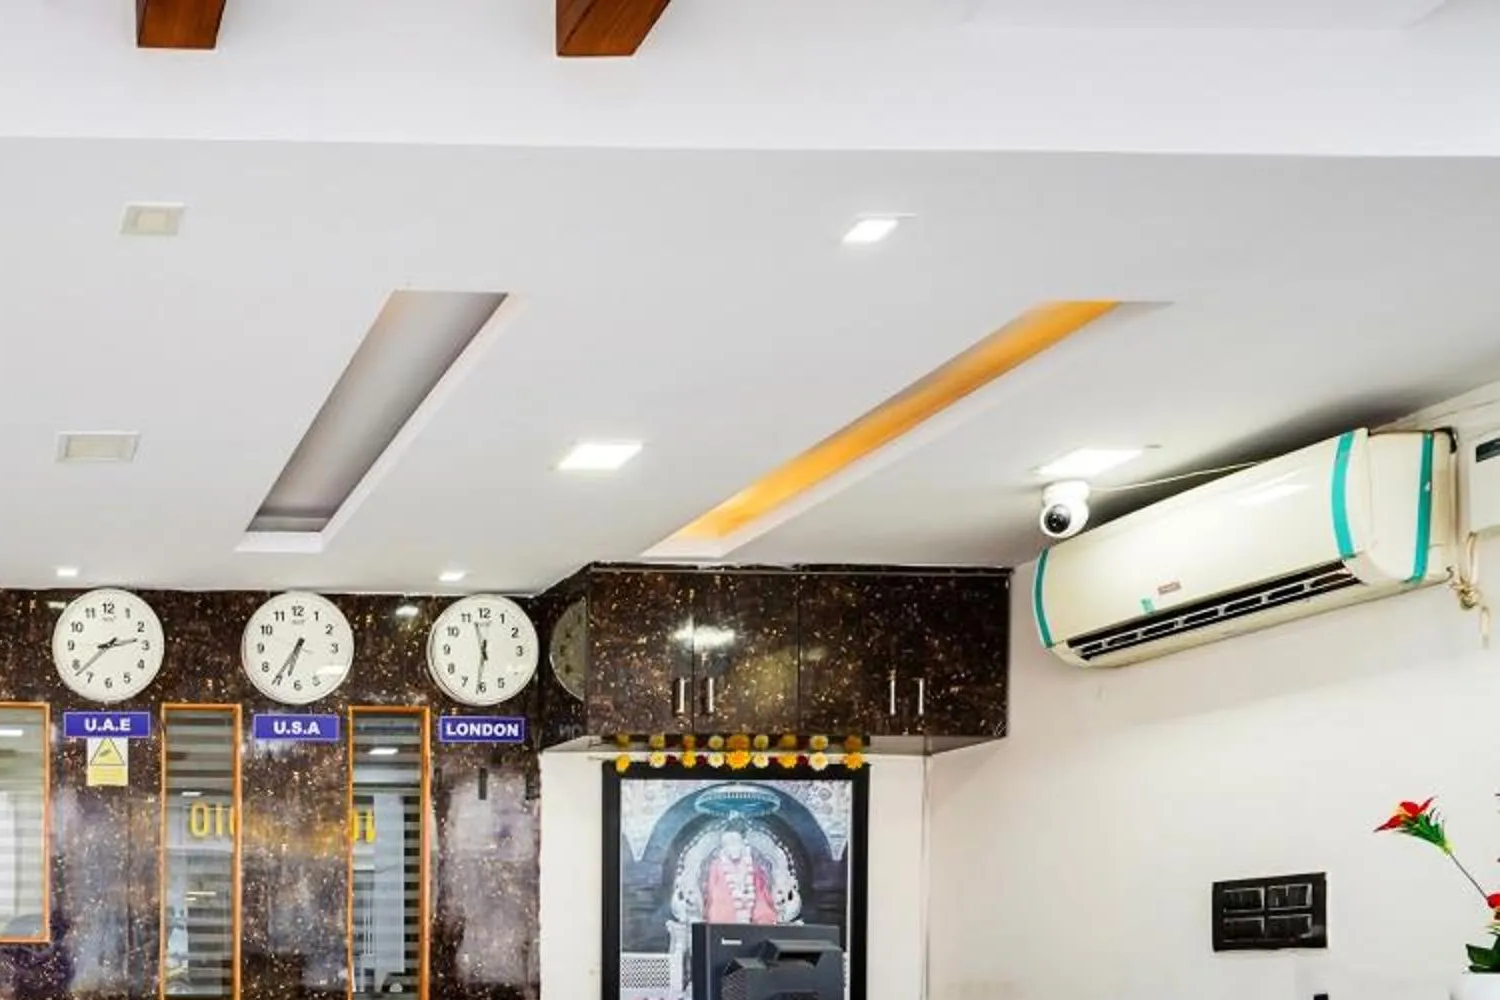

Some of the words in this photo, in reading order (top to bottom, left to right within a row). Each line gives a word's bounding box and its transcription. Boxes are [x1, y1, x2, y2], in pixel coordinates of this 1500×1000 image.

[85, 608, 95, 618] 11
[102, 603, 115, 614] 12
[125, 608, 130, 618] 1
[291, 606, 304, 616] 12
[478, 608, 491, 618] 12
[274, 611, 284, 621] 11
[314, 611, 319, 621] 1
[461, 613, 471, 623] 11
[500, 614, 505, 624] 1
[71, 622, 83, 632] 10
[137, 622, 145, 632] 2
[261, 625, 273, 635] 10
[325, 624, 333, 634] 2
[447, 627, 459, 637] 10
[511, 628, 518, 638] 2
[67, 640, 75, 650] 9
[142, 640, 149, 650] 3
[257, 643, 264, 653] 9
[331, 643, 339, 653] 3
[443, 645, 450, 655] 9
[516, 646, 524, 656] 3
[137, 659, 144, 669] 4
[262, 662, 269, 672] 8
[86, 673, 93, 683] 7
[105, 678, 112, 688] 6
[124, 673, 131, 684] 5
[461, 676, 468, 687] 7
[498, 678, 505, 688] 5
[294, 680, 302, 690] 6
[84, 718, 131, 731] U.A.E
[273, 721, 320, 735] U.S.A
[446, 723, 519, 737] LONDON
